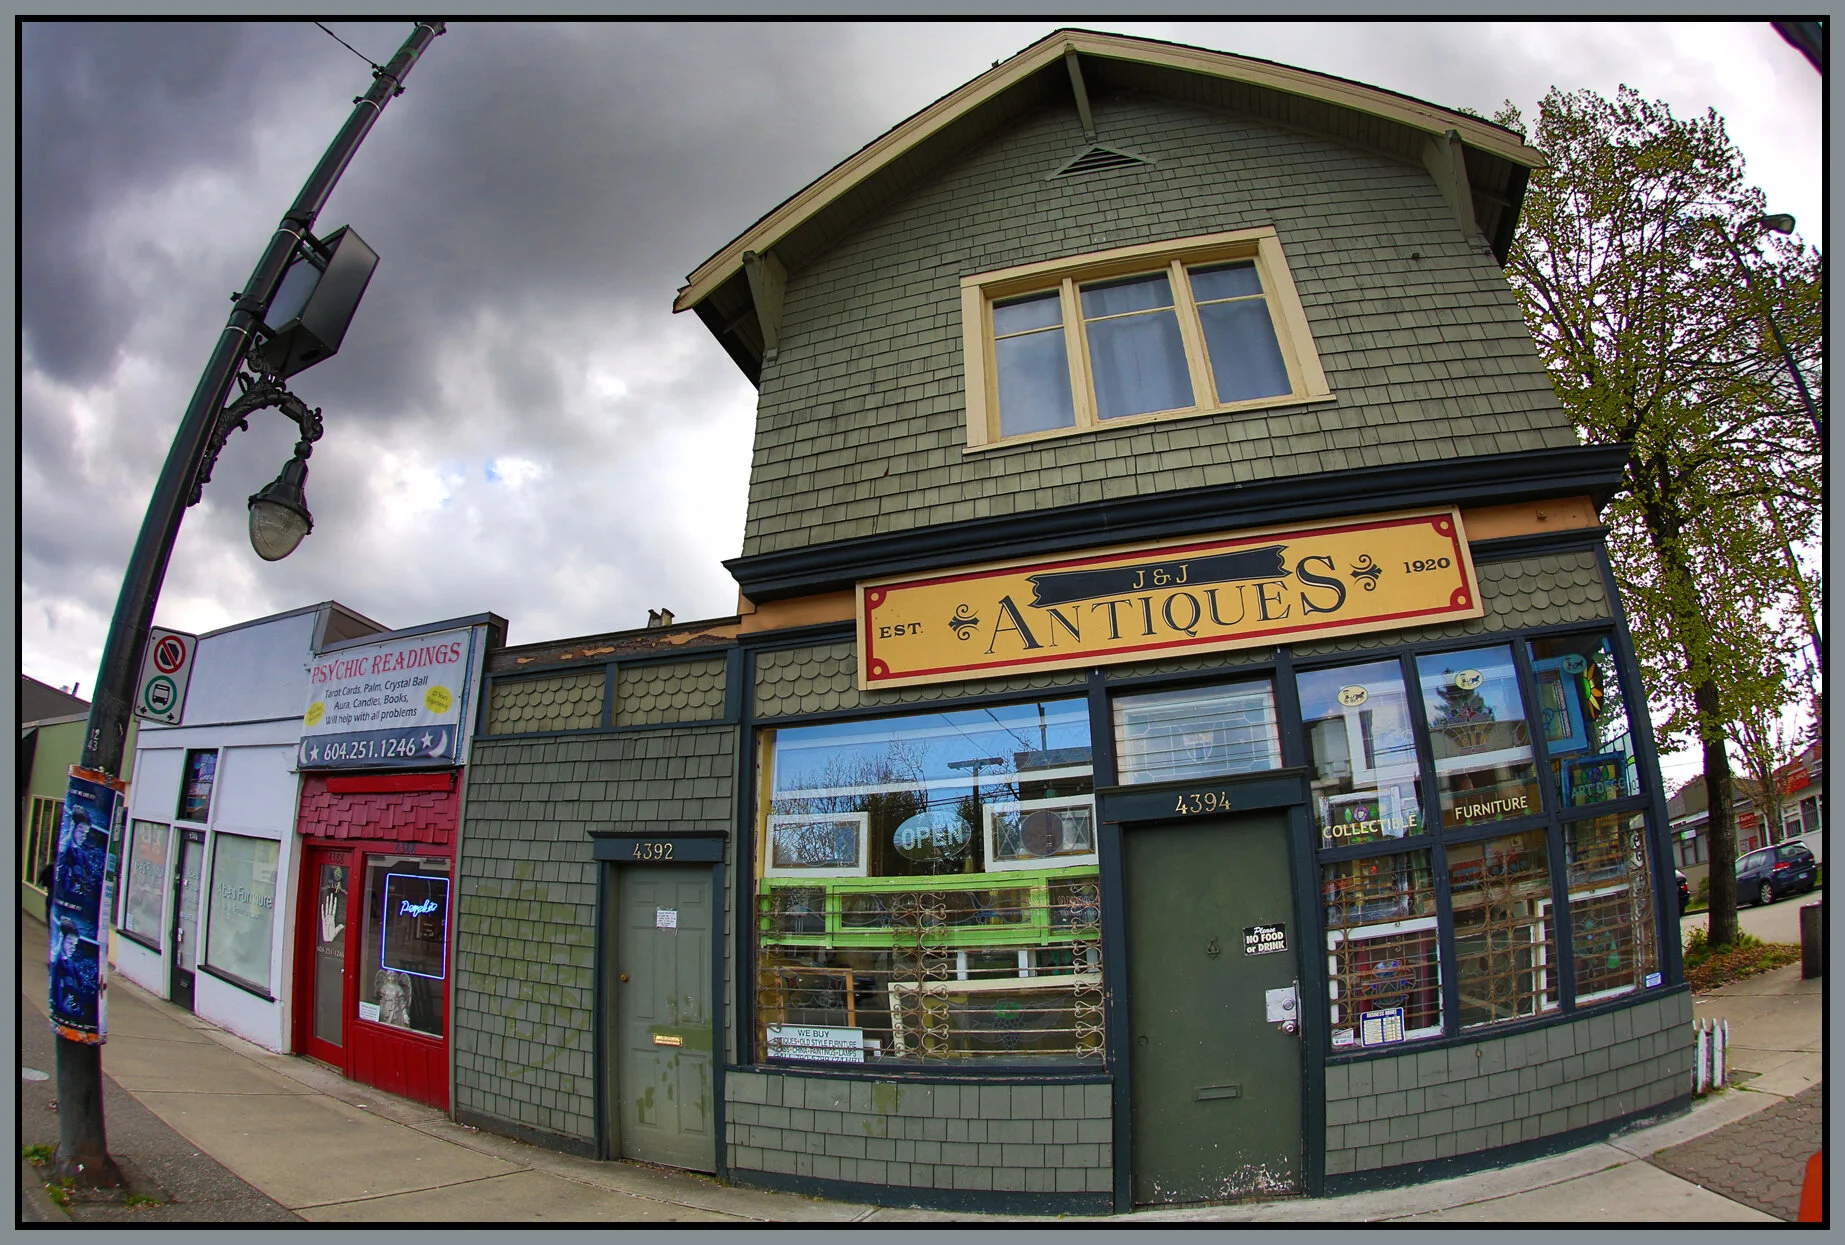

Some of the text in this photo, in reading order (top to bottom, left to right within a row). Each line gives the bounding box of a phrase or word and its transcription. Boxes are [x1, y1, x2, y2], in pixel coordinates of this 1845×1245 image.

[1402, 557, 1451, 575] 1920
[985, 555, 1347, 654] ANTIQUES
[879, 622, 924, 639] EST.
[311, 642, 461, 684] PSYCHIC READINGS
[325, 675, 429, 699] Tarot Cards, Palm, Crystal Ball
[334, 694, 409, 711] Aura, Candles, Books,
[325, 707, 418, 726] Will help with all problems
[323, 737, 416, 761] 604.251.1246
[1571, 783, 1594, 799] ART
[1596, 778, 1626, 794] DECO
[1175, 791, 1231, 815] 4394
[1454, 795, 1529, 820] FURNITURE
[902, 821, 963, 851] OPEN
[1323, 814, 1418, 839] COLLECTIBLE
[632, 843, 674, 860] 4392
[1246, 931, 1284, 944] NO FOOD
[1254, 926, 1276, 935] Please
[1258, 940, 1285, 952] DRINK
[797, 1029, 830, 1038] WE BUY
[800, 1038, 810, 1047] OLD
[811, 1039, 828, 1047] STYLE
[829, 1040, 857, 1049] FURNITURE
